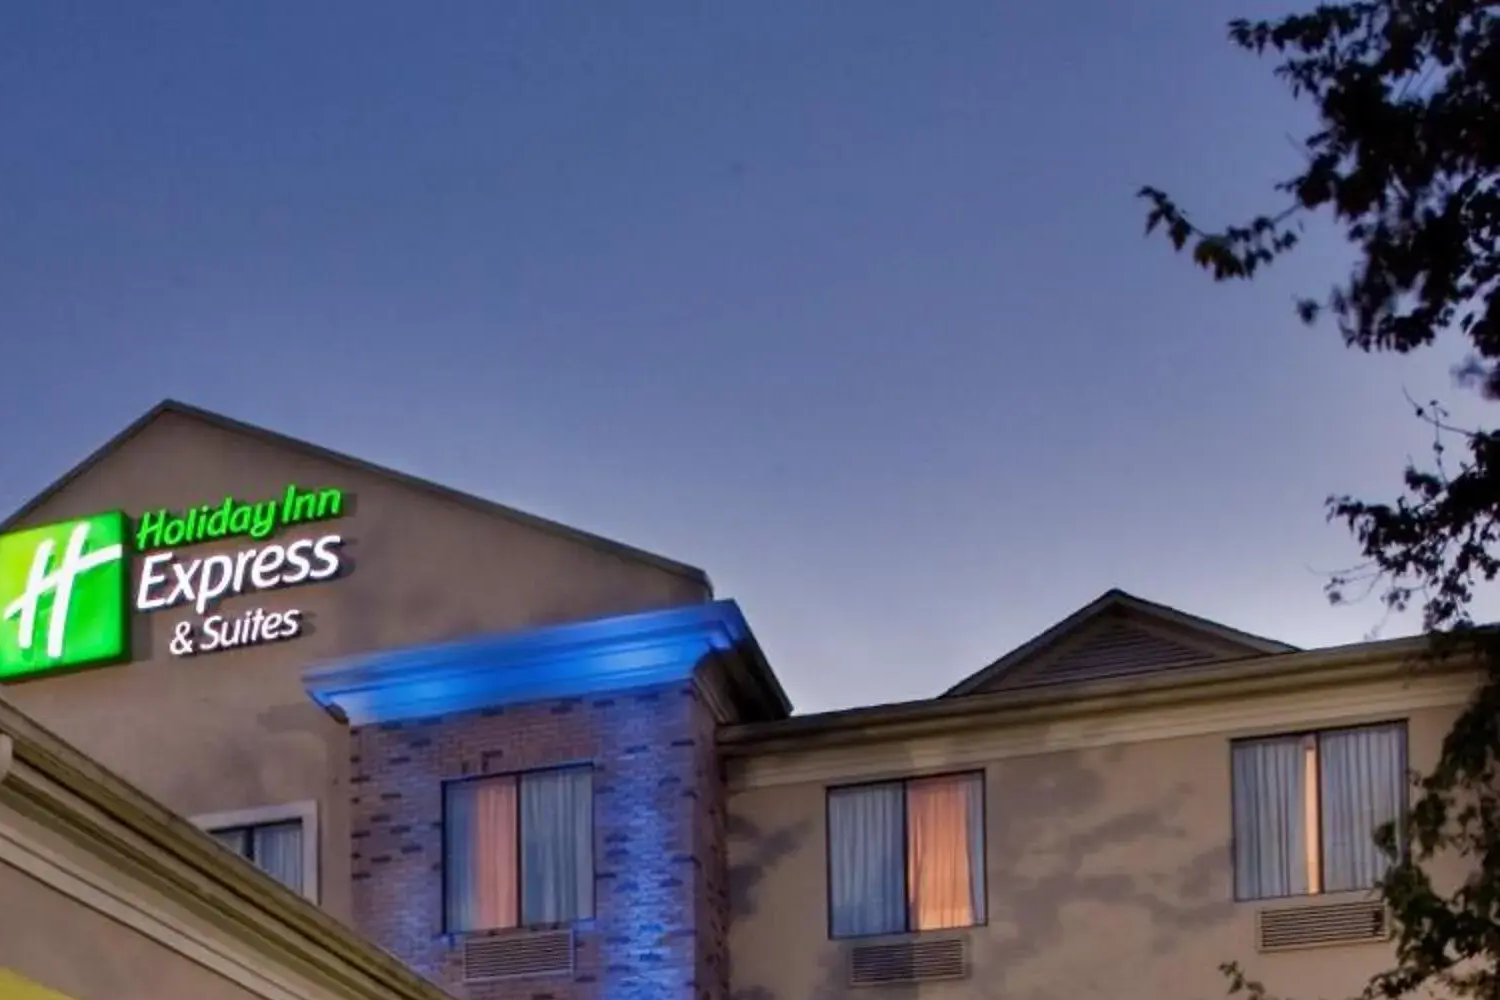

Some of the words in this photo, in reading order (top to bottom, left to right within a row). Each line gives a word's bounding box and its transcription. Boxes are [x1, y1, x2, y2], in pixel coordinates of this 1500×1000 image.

[136, 498, 275, 549] Holiday
[282, 485, 341, 521] Inn
[3, 522, 122, 658] H
[137, 534, 341, 613] Express
[169, 621, 193, 655] &
[200, 608, 300, 649] Suites
